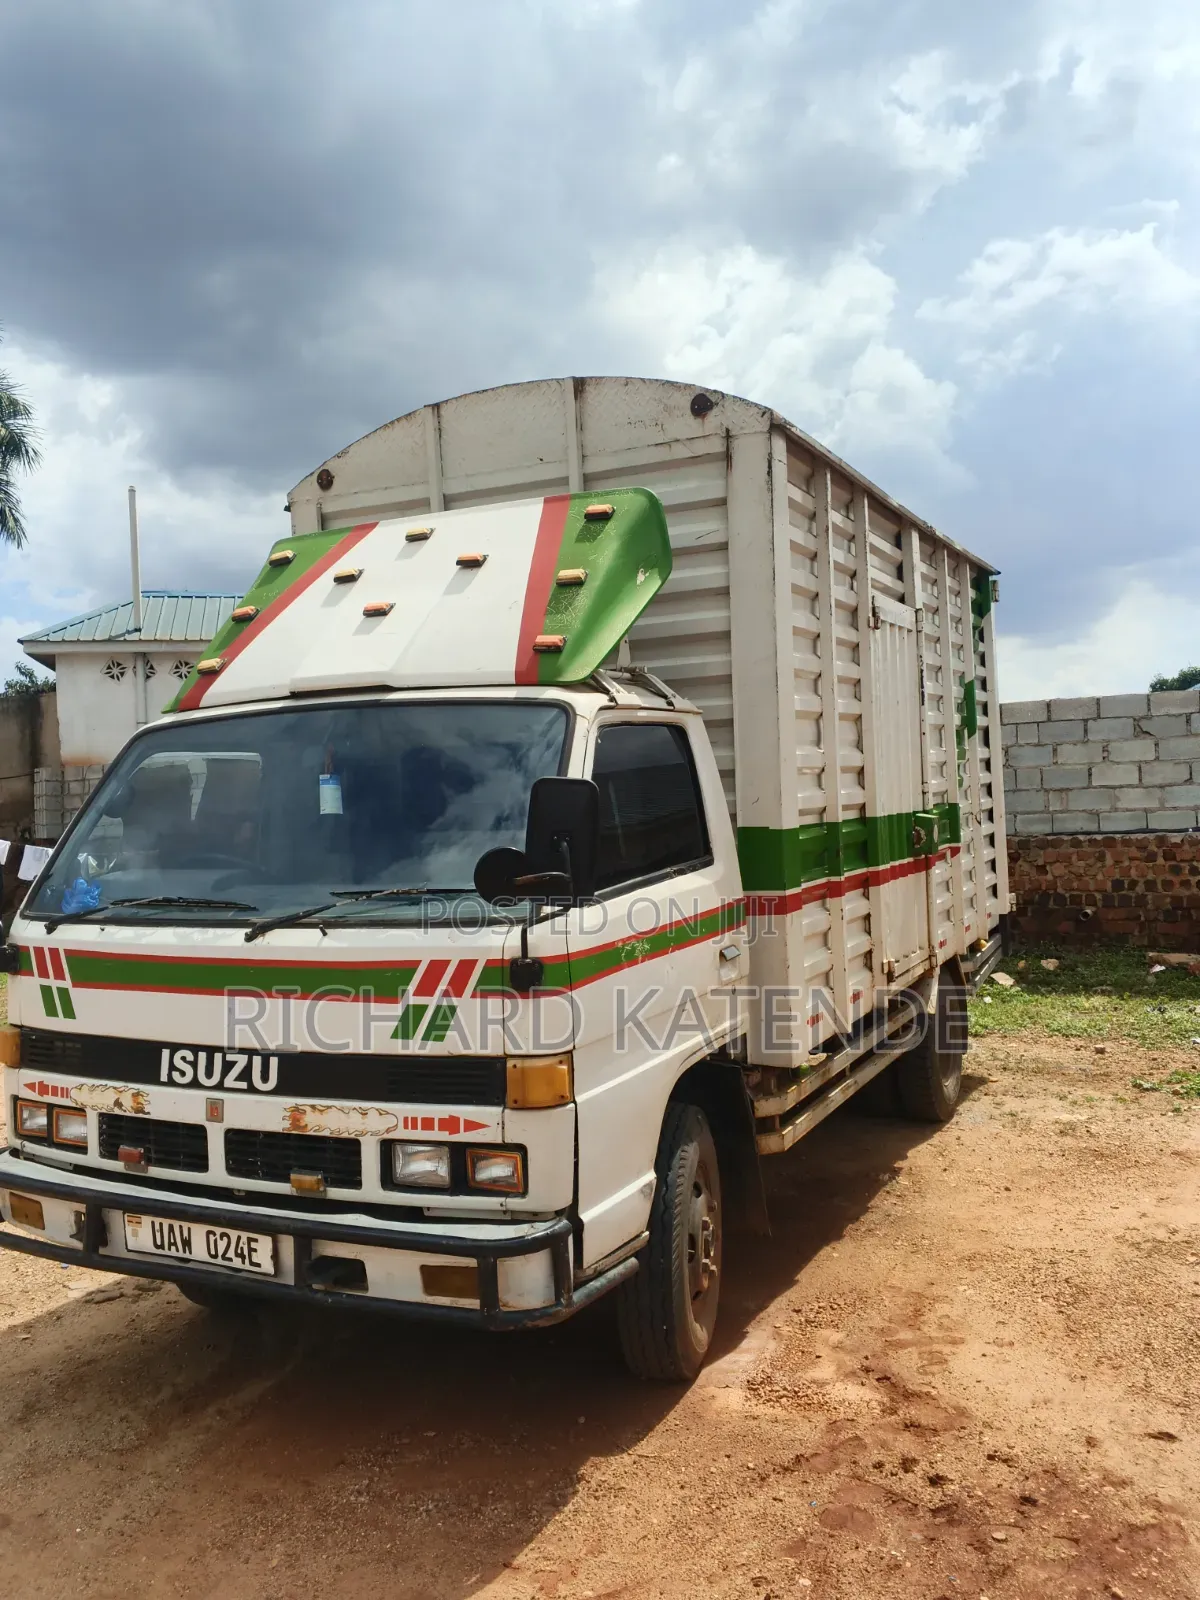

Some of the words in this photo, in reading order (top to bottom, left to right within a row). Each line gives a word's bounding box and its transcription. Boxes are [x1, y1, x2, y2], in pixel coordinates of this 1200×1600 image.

[160, 1048, 278, 1092] ISUZU
[151, 1220, 193, 1255] UAW
[205, 1229, 262, 1269] 024E
